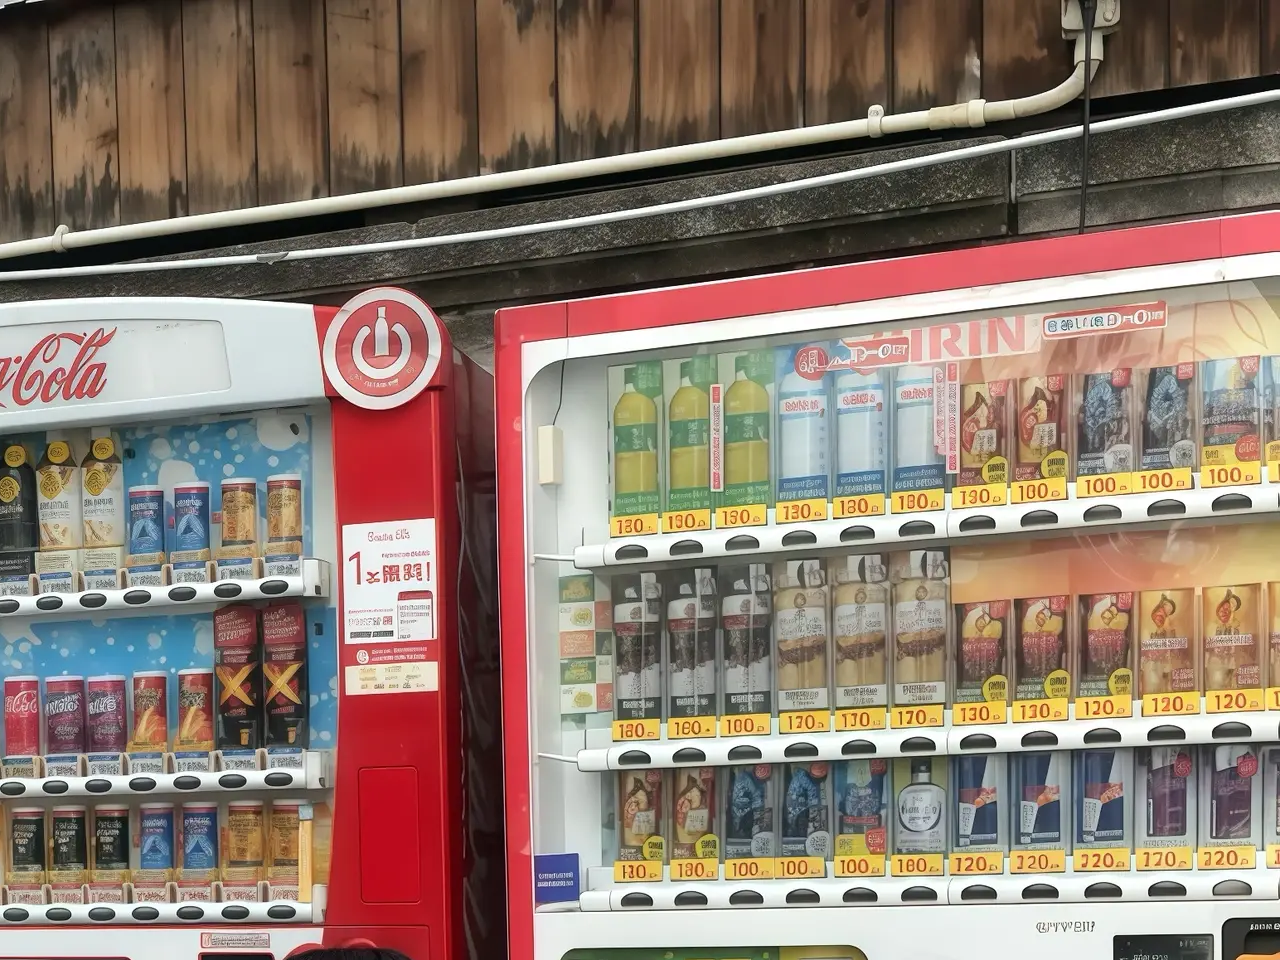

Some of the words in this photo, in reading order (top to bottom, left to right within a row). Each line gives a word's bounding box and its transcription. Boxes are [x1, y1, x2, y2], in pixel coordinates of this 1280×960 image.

[908, 315, 1026, 363] IRIN
[1141, 472, 1172, 489] 100
[1209, 467, 1241, 483] 100
[1217, 692, 1246, 709] 120
[732, 861, 759, 876] 100
[780, 860, 808, 876] 100
[840, 858, 869, 874] 100
